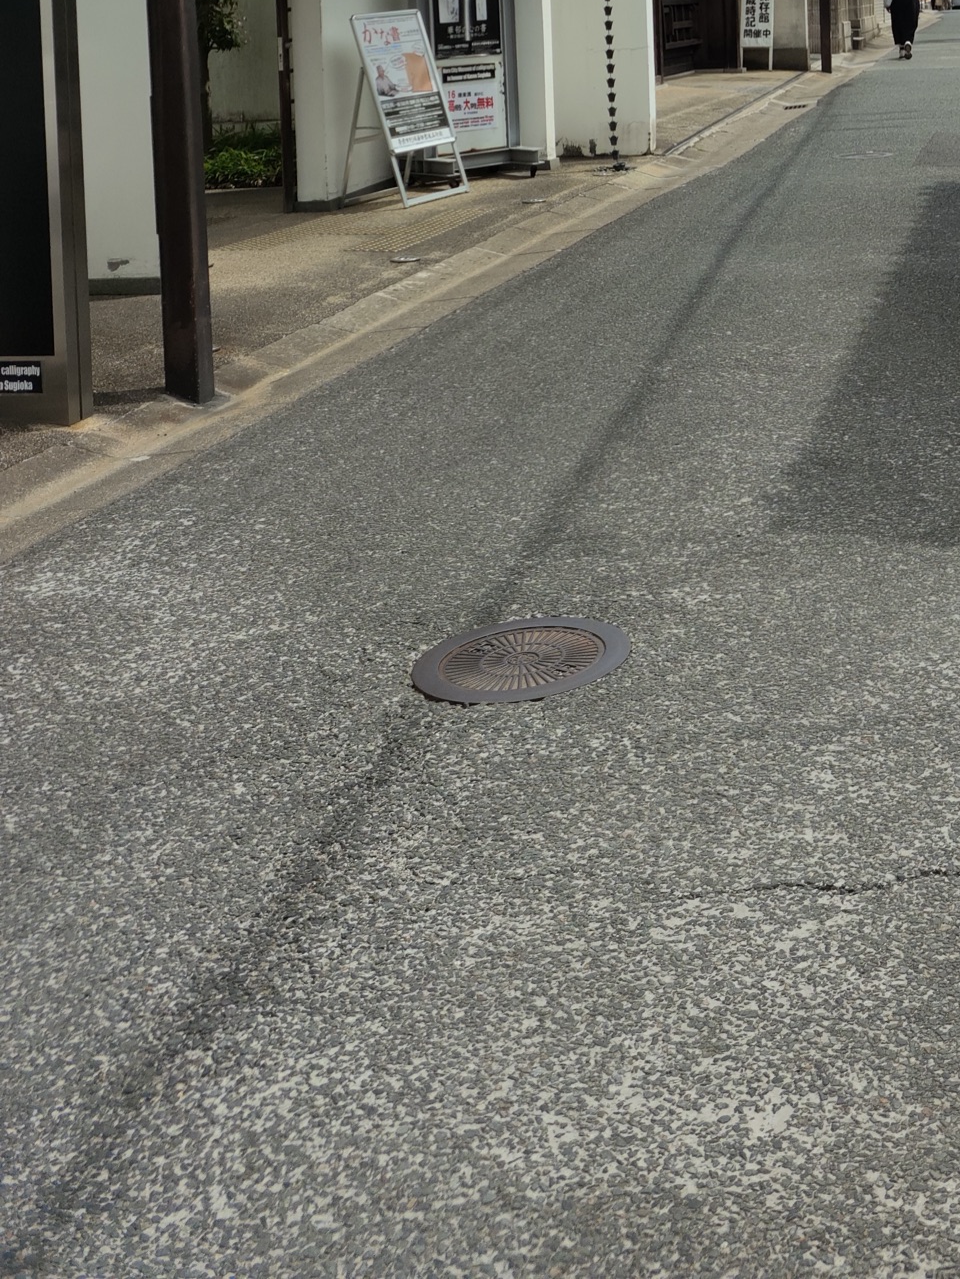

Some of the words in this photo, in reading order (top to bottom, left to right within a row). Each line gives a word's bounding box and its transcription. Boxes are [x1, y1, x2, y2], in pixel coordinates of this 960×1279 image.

[743, 29, 771, 39] 開催中
[1, 364, 40, 377] calligraphy
[4, 379, 33, 392] Sugioka
